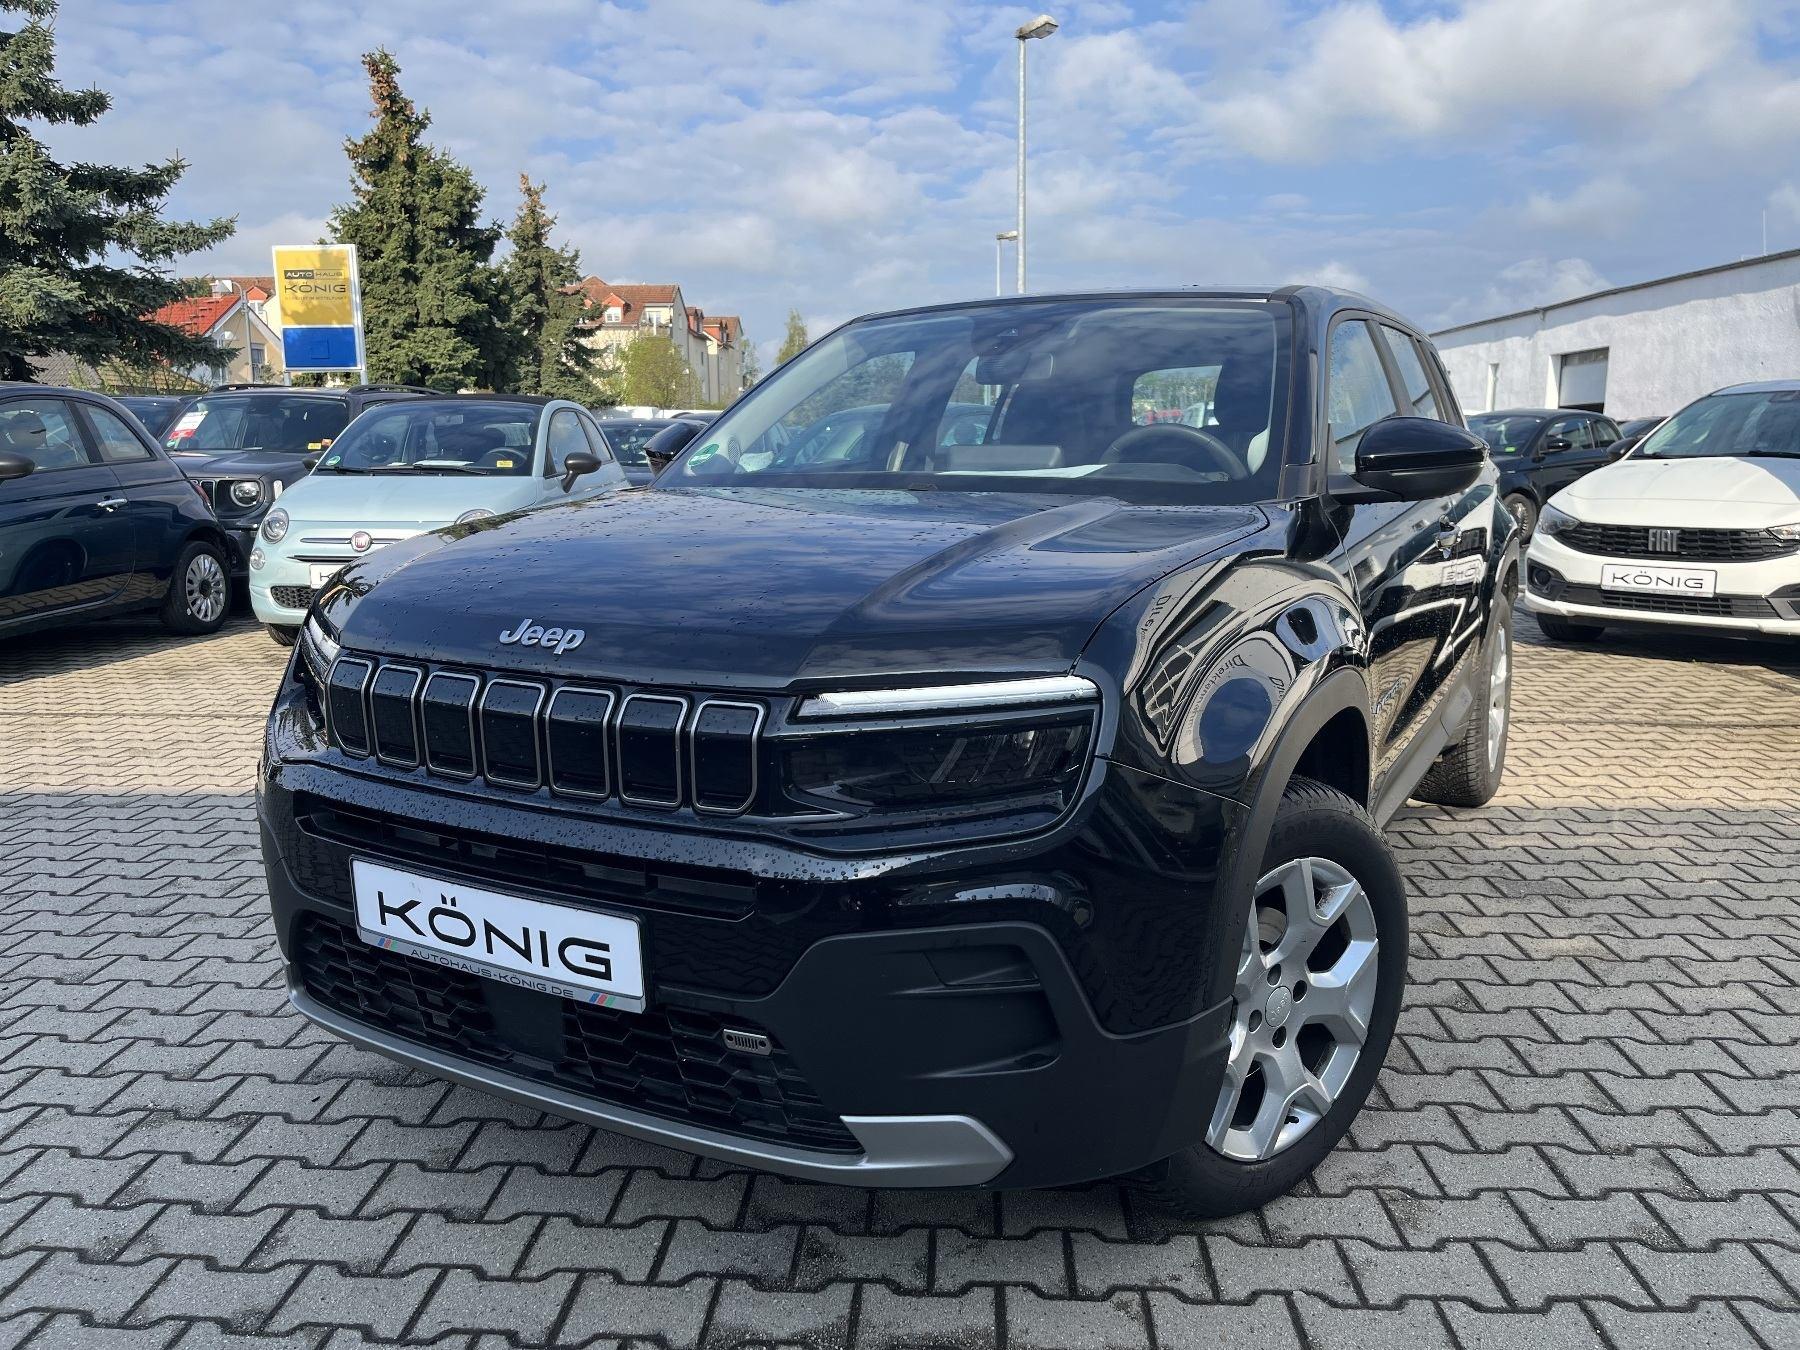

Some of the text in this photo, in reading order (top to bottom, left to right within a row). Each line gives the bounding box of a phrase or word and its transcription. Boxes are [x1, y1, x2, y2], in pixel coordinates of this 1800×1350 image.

[284, 281, 346, 293] KÖNIG
[1648, 528, 1680, 553] FIAT
[1612, 570, 1704, 589] KÖNIG
[499, 618, 586, 655] Jeep
[377, 890, 613, 982] KÖNIG
